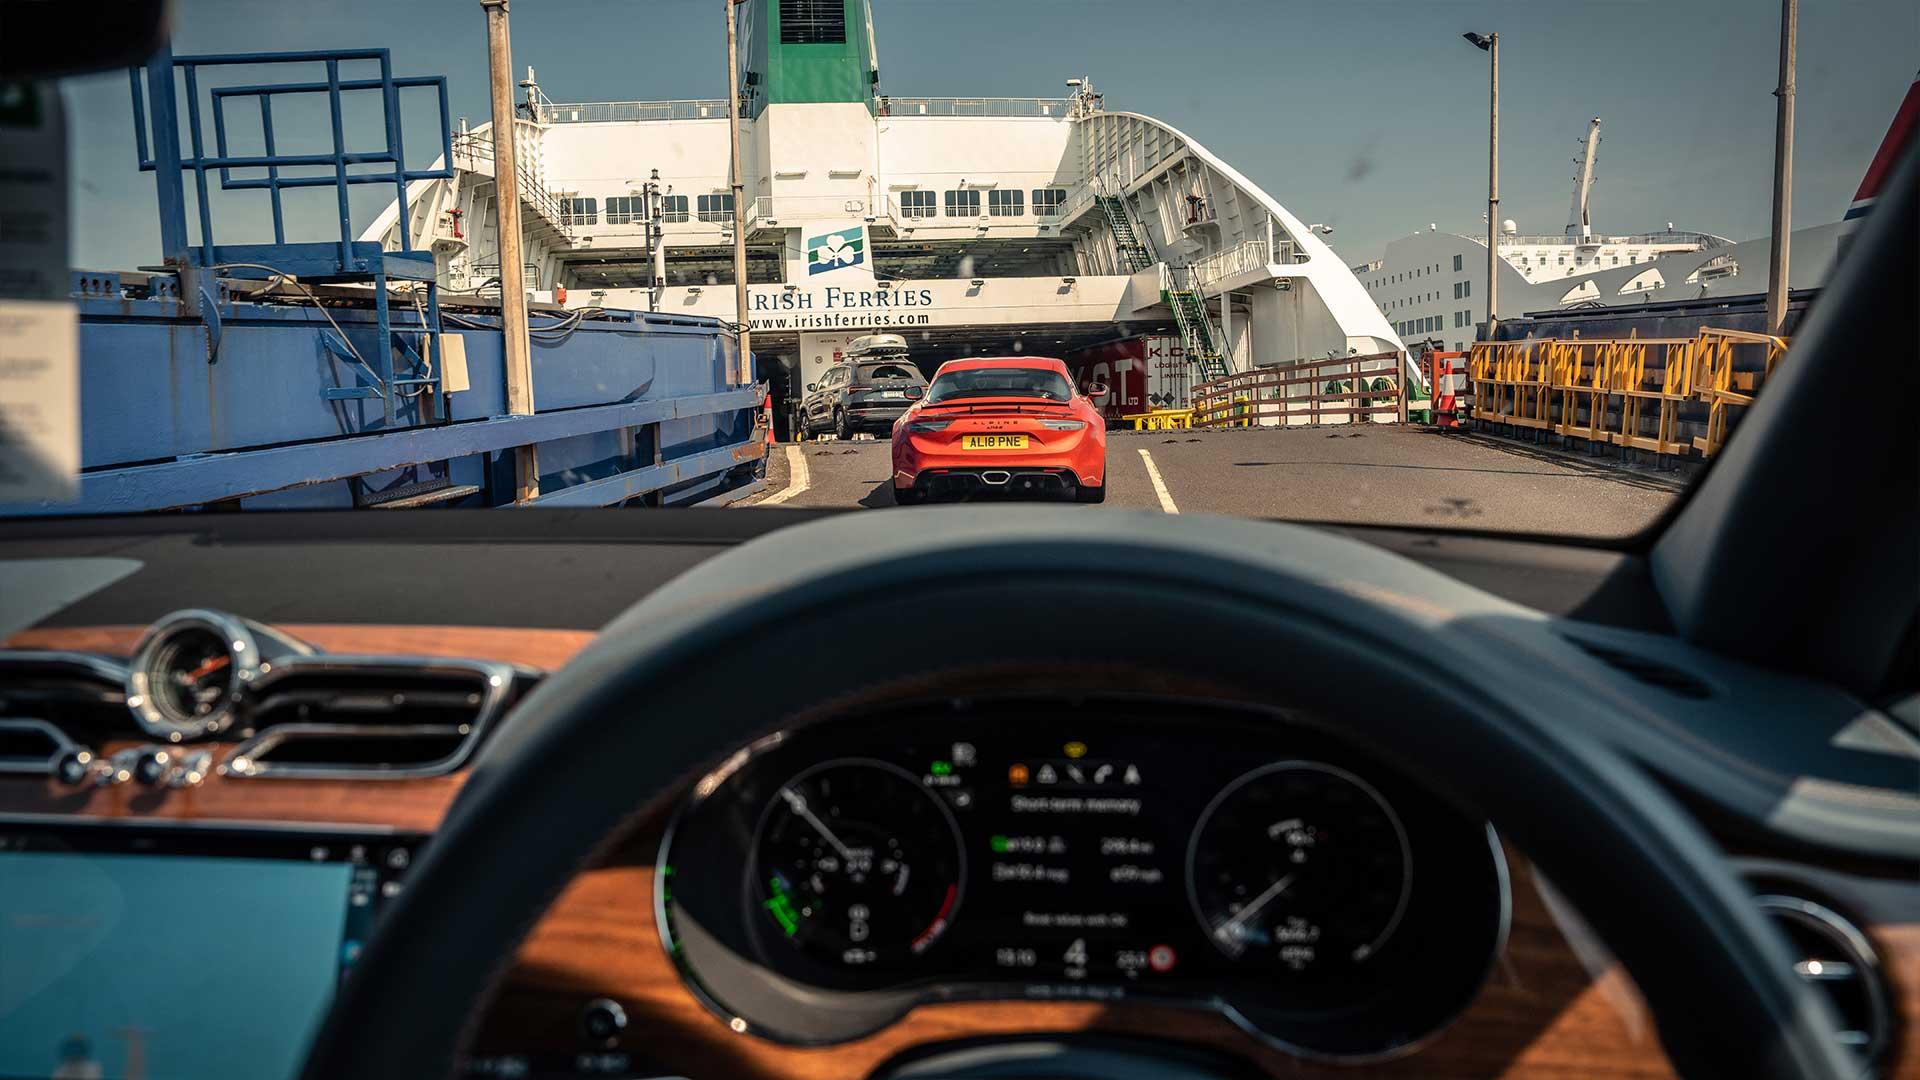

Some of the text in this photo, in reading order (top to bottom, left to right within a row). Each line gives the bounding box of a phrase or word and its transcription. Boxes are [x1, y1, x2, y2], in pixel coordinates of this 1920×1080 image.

[825, 287, 932, 308] FERRIES
[749, 313, 930, 329] www.irishferries.com
[1128, 397, 1139, 406] LTD
[998, 436, 1021, 447] PNE
